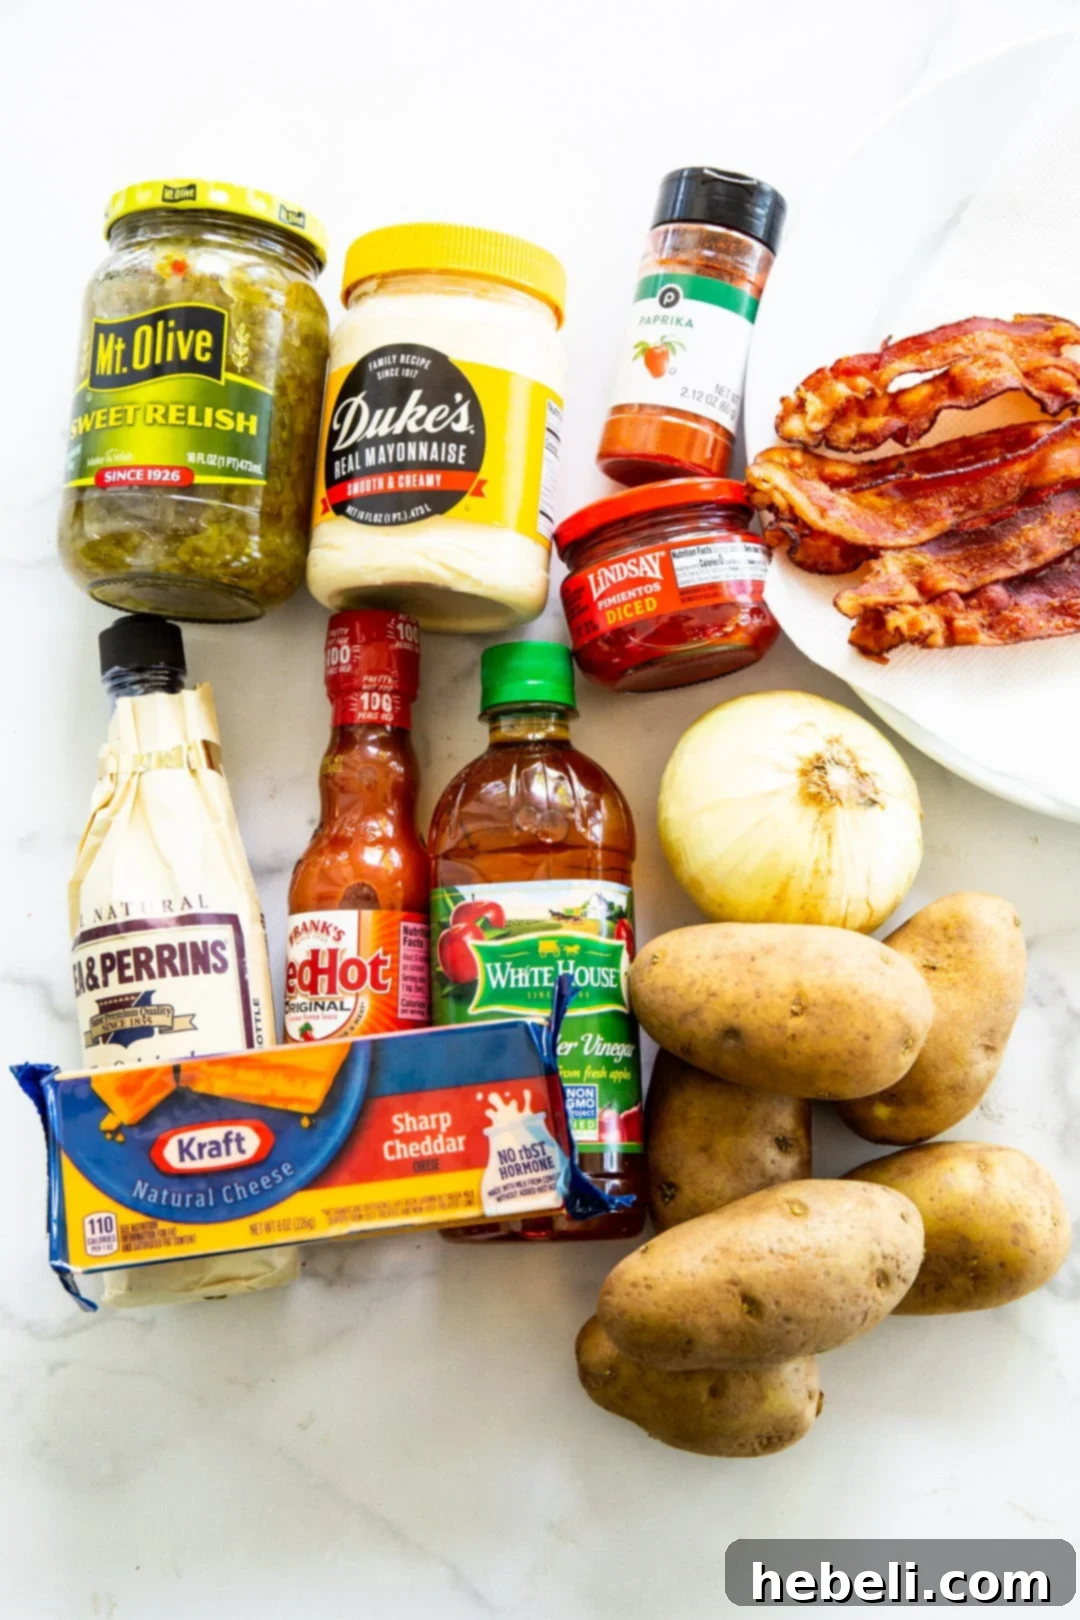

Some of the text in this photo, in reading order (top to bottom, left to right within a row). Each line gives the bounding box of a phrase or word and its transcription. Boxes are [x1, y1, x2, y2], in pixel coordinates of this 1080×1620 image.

[638, 315, 694, 329] PAPRIKA
[95, 319, 213, 375] Mt. Olive
[368, 353, 432, 372] FAMILY RECIPE
[376, 368, 419, 381] SINCE 1917
[679, 386, 705, 402] 2.12
[69, 403, 258, 440] SWEET RELISH
[333, 441, 467, 480] REAL MAYONNAISE
[104, 468, 181, 483] SINCE 1926
[346, 476, 385, 496] SMOOTH
[397, 474, 443, 489] CREAMY
[596, 582, 662, 610] PIMIENTOS
[605, 597, 658, 625] DICED
[360, 691, 393, 713] 100
[92, 894, 209, 923] NATURAL
[288, 919, 346, 948] FRANK'S
[403, 936, 424, 948] Facts
[286, 948, 389, 996] edHot
[485, 960, 618, 989] WHITE HOUSE
[140, 1005, 172, 1018] Quality
[284, 1000, 351, 1014] ORIGINAL
[253, 997, 264, 1049] OTTLE
[581, 1033, 635, 1063] Vinegar
[583, 1064, 607, 1083] fresh
[566, 1087, 594, 1098] NON
[566, 1098, 595, 1108] GMO
[392, 1112, 452, 1135] Sharp
[177, 1130, 247, 1163] Kraft
[382, 1133, 466, 1161] Cheddar
[497, 1140, 547, 1165] NO rbST
[498, 1155, 555, 1180] HORMONE
[131, 1179, 214, 1208] Natural
[222, 1160, 295, 1204] Cheese
[88, 1215, 114, 1236] 110
[87, 1234, 116, 1245] CALORIES
